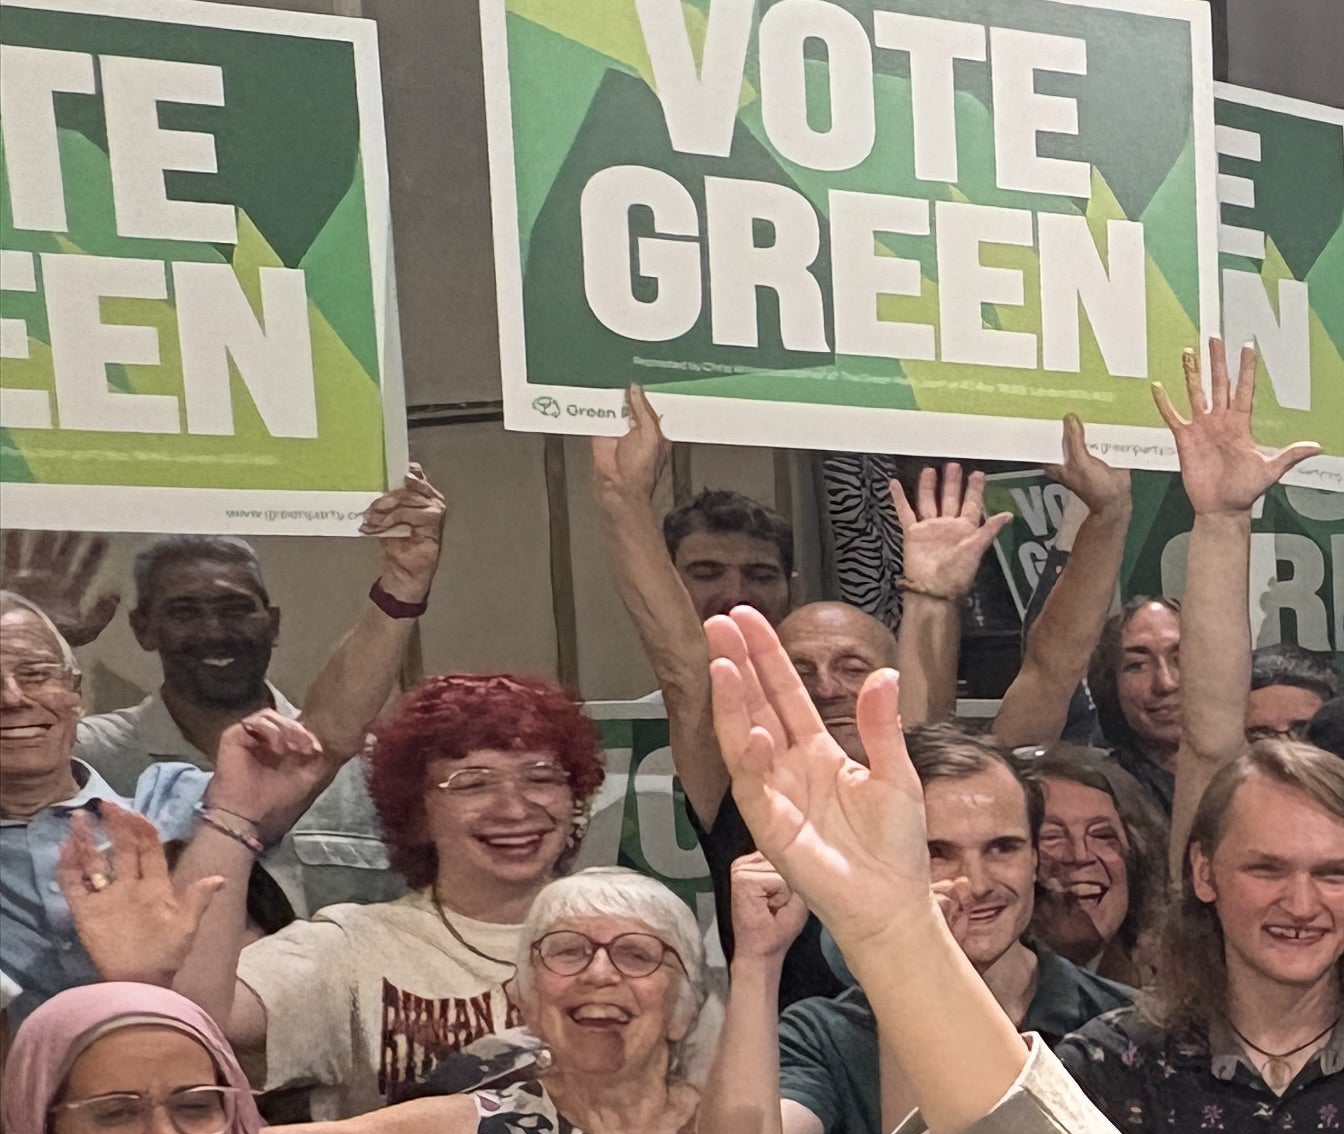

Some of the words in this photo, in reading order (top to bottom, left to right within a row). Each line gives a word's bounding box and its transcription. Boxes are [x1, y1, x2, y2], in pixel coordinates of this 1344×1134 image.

[0, 44, 238, 244] TE
[637, 0, 1091, 198] VOTE
[580, 164, 1147, 378] GREEN
